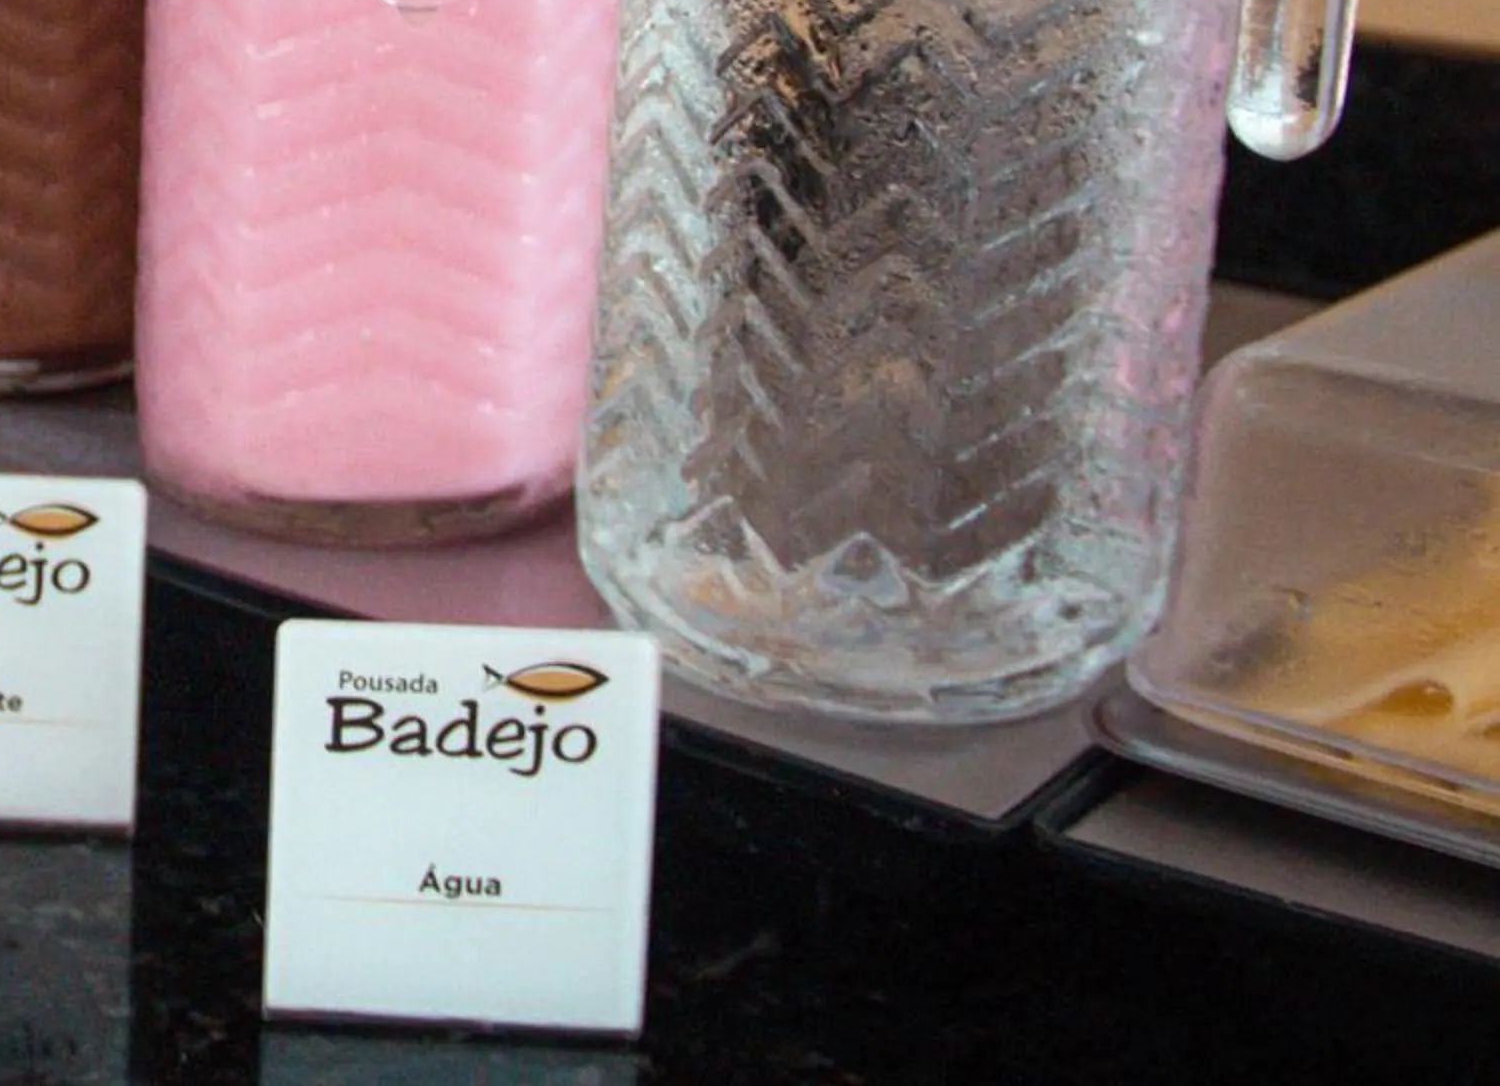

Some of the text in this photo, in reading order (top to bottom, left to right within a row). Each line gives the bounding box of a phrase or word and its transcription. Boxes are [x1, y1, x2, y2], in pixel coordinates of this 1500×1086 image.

[338, 670, 439, 695] Pousada
[324, 696, 598, 778] Badejo
[417, 862, 502, 898] Água
